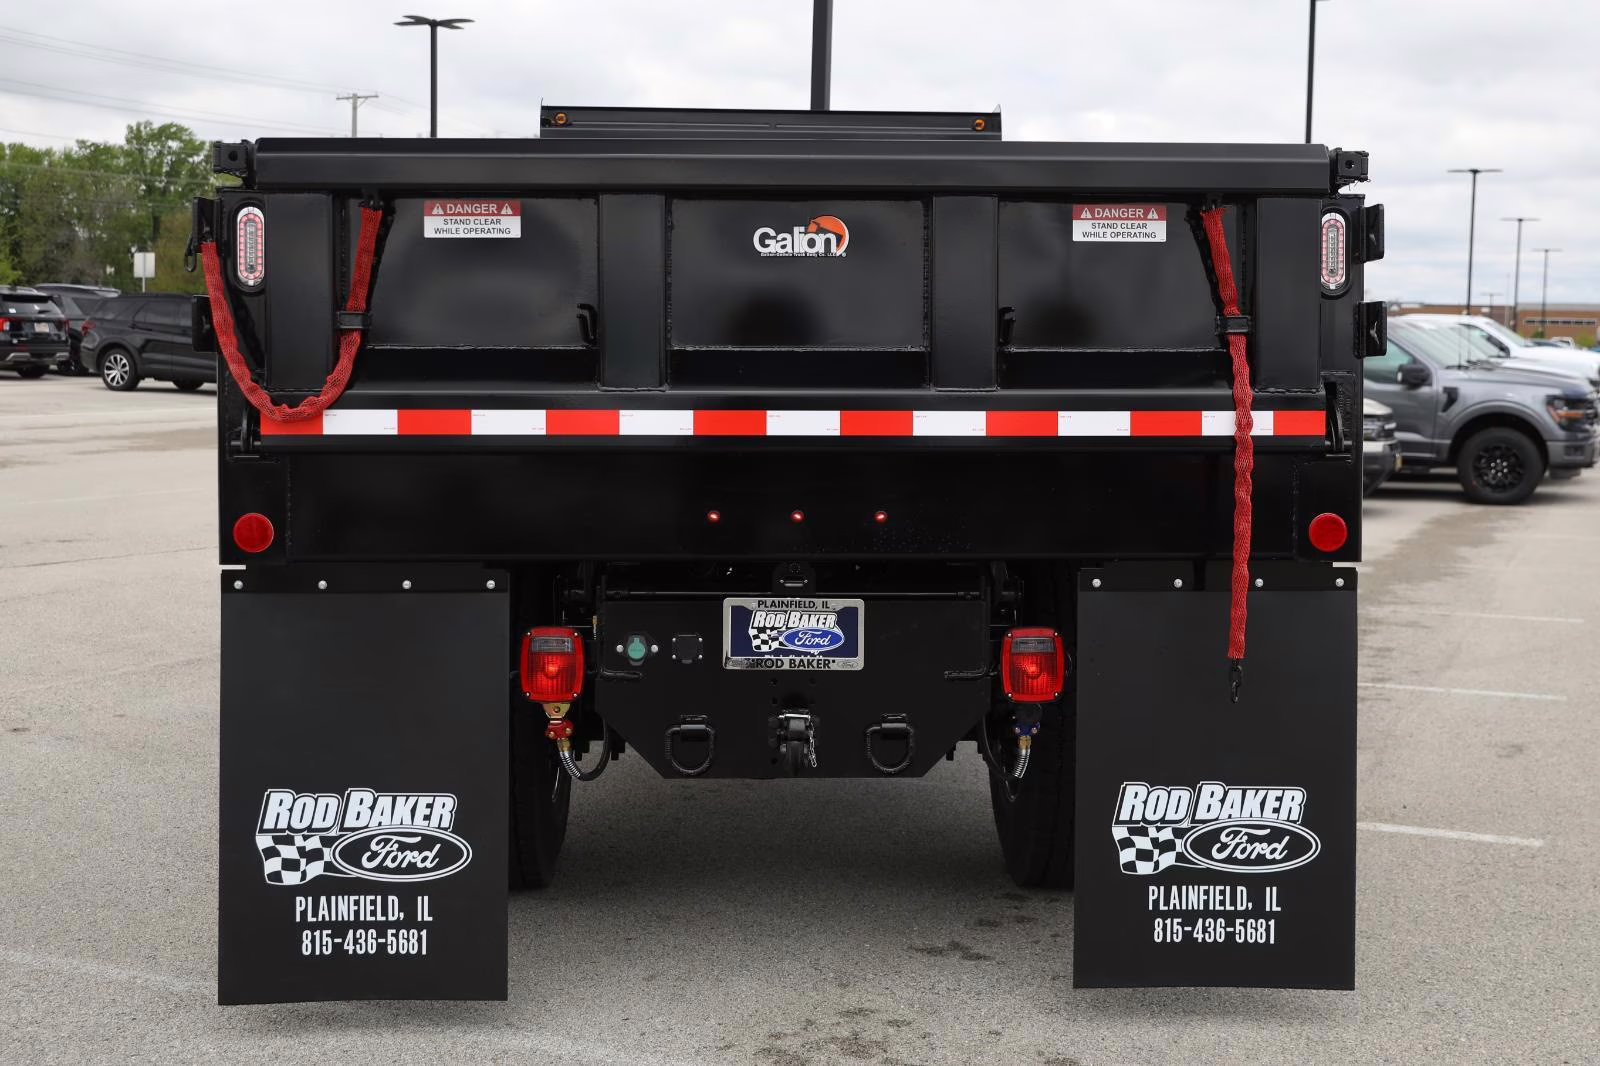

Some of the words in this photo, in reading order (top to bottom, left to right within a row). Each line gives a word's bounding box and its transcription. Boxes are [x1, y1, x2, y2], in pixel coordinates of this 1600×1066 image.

[446, 203, 498, 214] DANGER
[1094, 208, 1144, 218] DANGER
[434, 227, 461, 235] WHILE
[462, 227, 511, 235] OPERATING
[443, 218, 471, 226] STAND
[473, 218, 502, 226] CLEAR
[1091, 222, 1118, 230] STAND
[1120, 222, 1148, 230] CLEAR
[753, 226, 837, 254] Galion
[1082, 231, 1108, 239] WHILE
[1109, 231, 1157, 239] OPERATING
[757, 600, 819, 610] PLAINFIELD,
[821, 600, 830, 609] IL
[752, 611, 786, 628] ROD
[787, 611, 837, 629] BAKER
[794, 630, 832, 646] Ford
[261, 790, 341, 831] ROD
[343, 789, 456, 829] BAKER
[1117, 783, 1192, 823] ROD
[1193, 782, 1304, 822] BAKER
[361, 834, 441, 869] Ford
[1211, 826, 1290, 860] Ford
[295, 895, 405, 922] PLAINFIELD,
[416, 895, 433, 921] IL
[1148, 885, 1253, 911] PLAINFIELD,
[1265, 886, 1282, 911] IL
[1153, 917, 1276, 944] 815-436-5681
[301, 928, 428, 956] 815-436-5681
